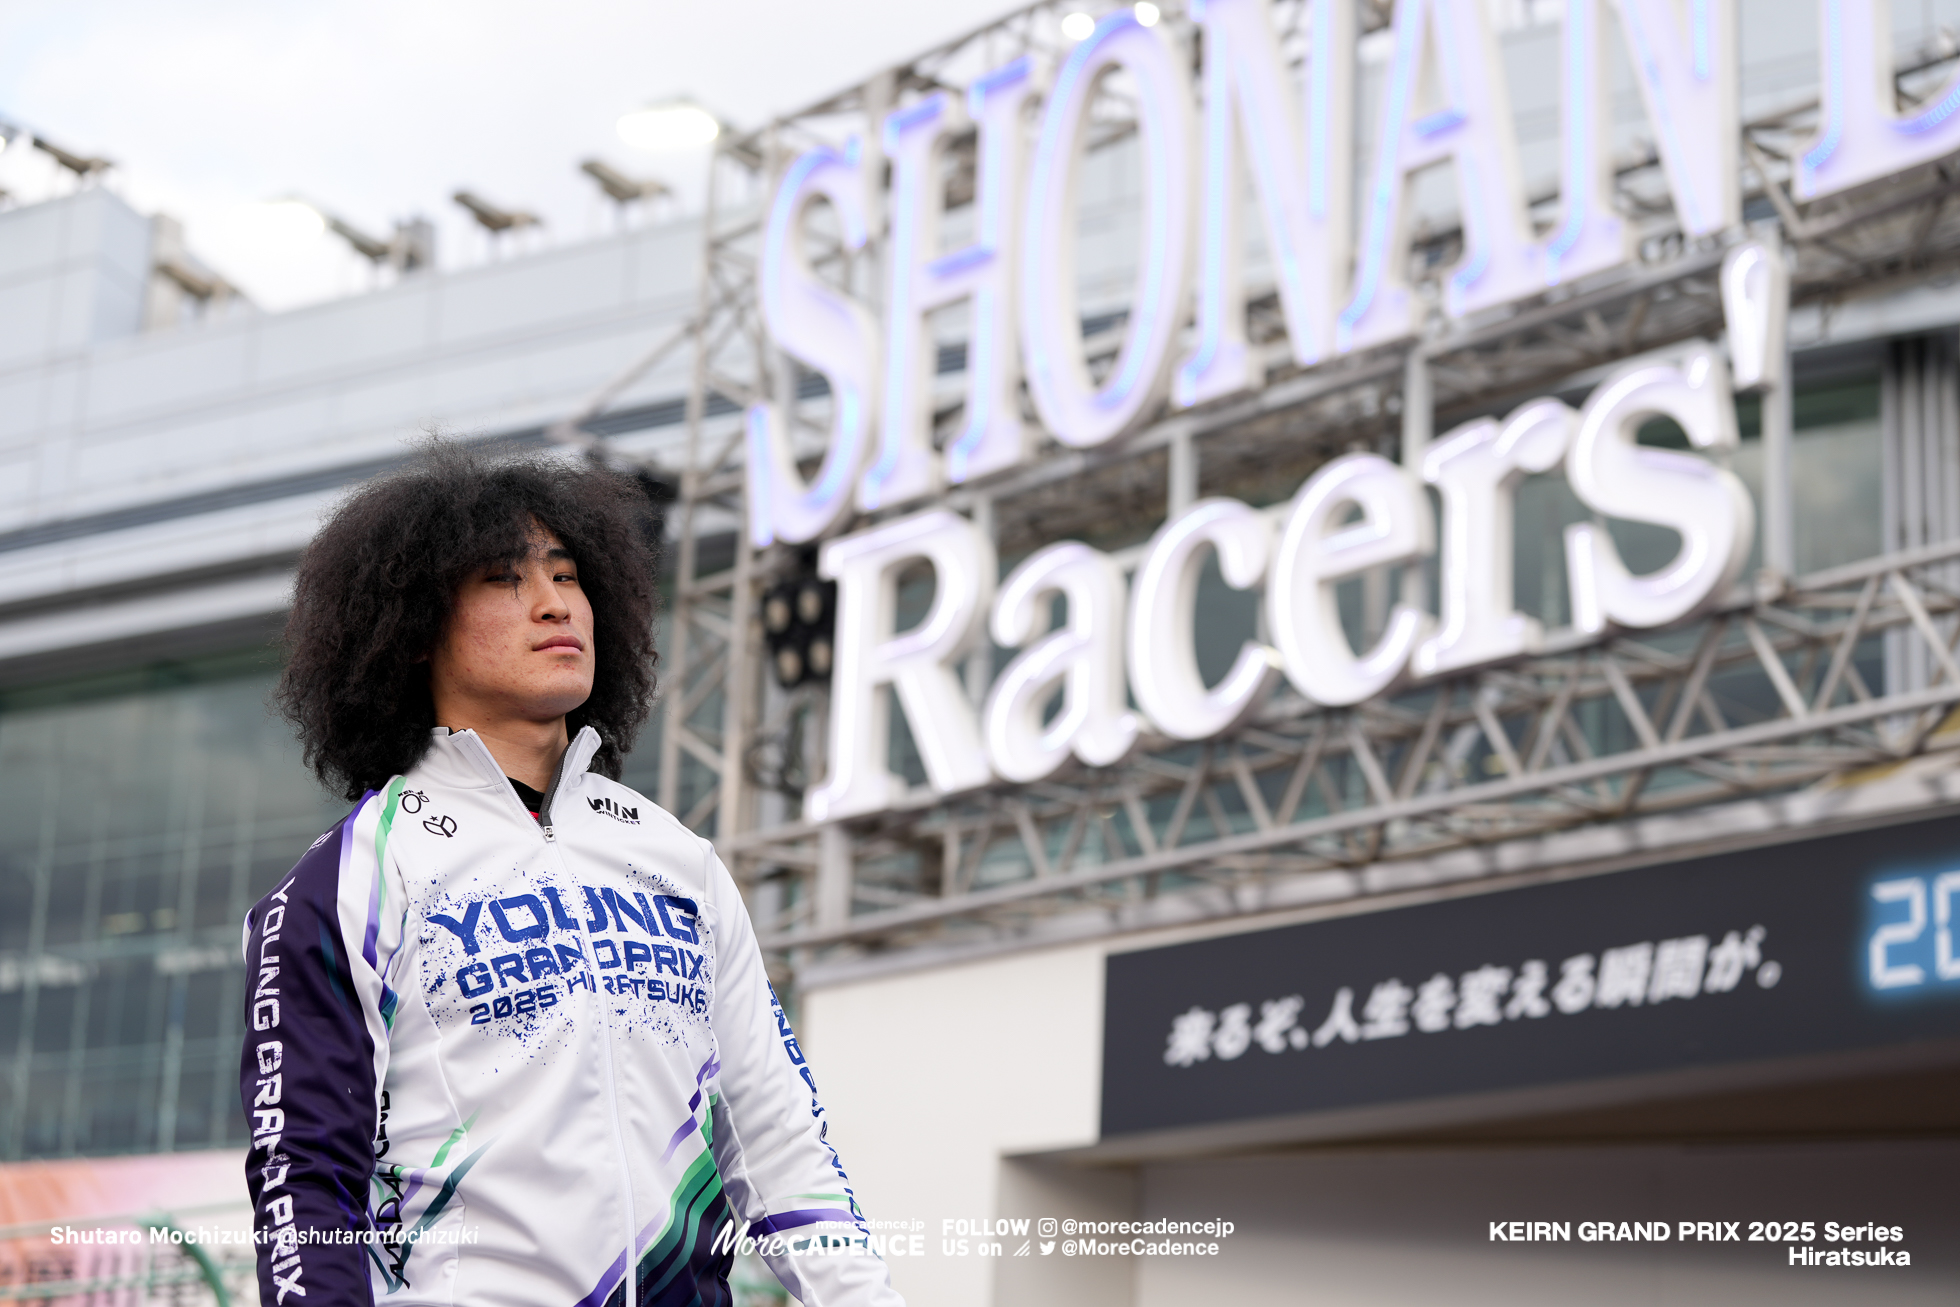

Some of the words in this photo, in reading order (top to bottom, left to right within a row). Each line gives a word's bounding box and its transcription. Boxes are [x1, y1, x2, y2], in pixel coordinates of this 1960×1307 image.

[253, 875, 296, 1032] YOUNG
[426, 885, 700, 946] YOUNG
[456, 938, 621, 1000] GRAND
[622, 940, 705, 984] PRIX
[470, 983, 558, 1026] 2025
[252, 1039, 292, 1193] GRAND
[265, 1193, 307, 1306] PRIX
